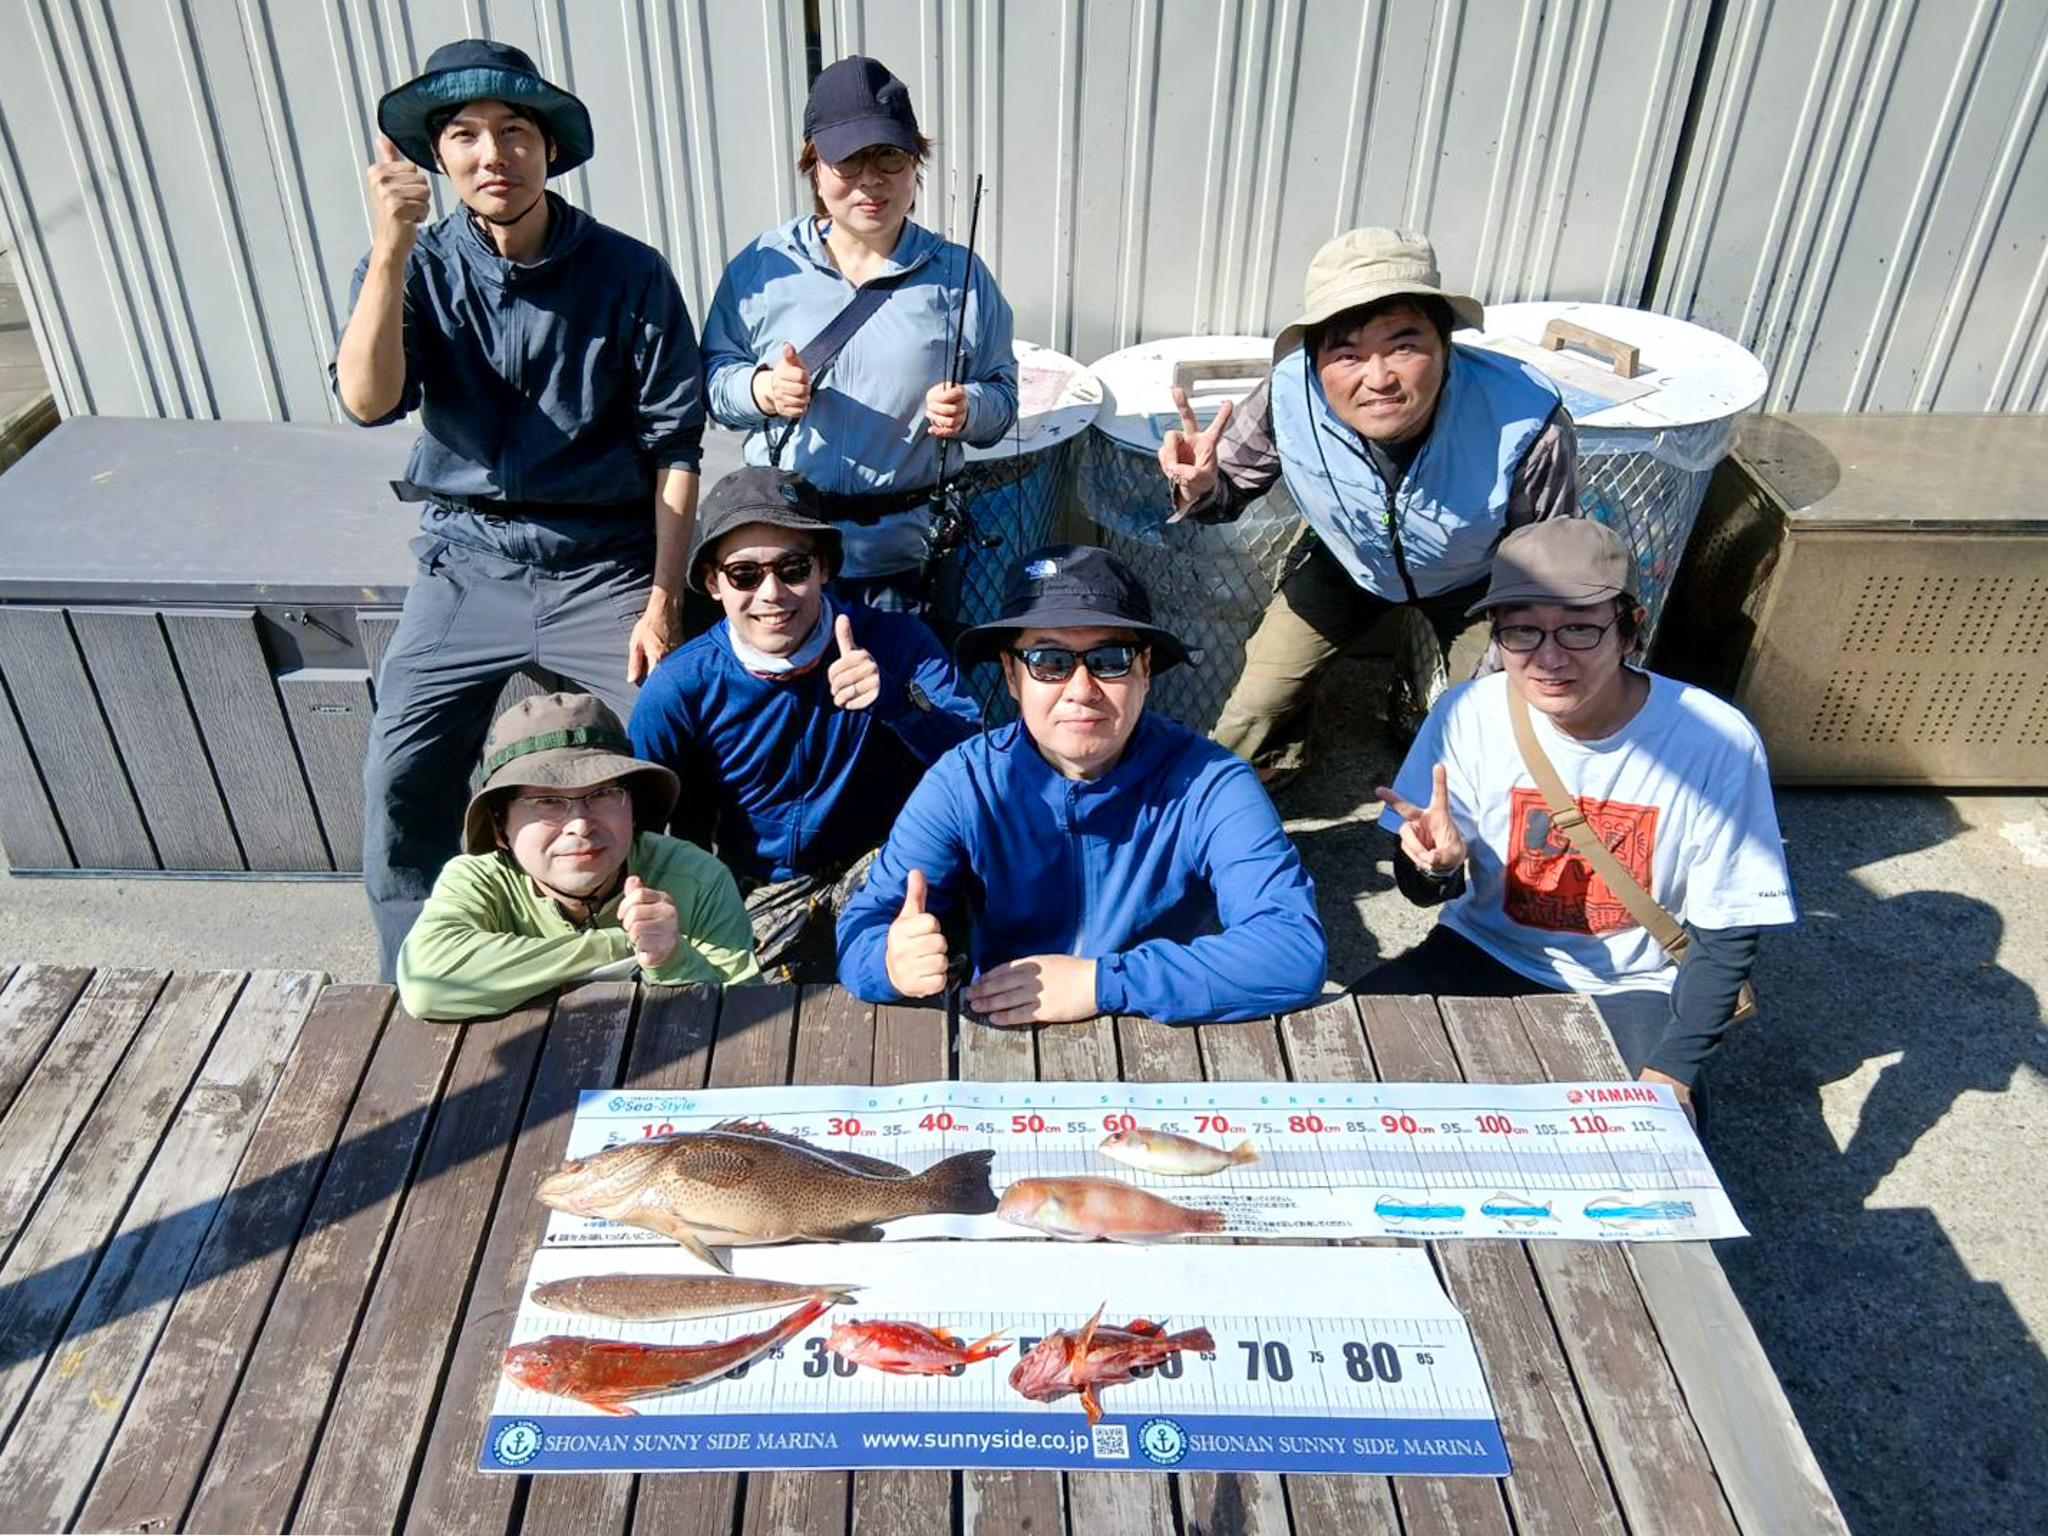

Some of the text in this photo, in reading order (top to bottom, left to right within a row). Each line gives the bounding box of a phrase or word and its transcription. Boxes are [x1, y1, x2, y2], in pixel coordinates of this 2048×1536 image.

[624, 1099, 697, 1113] Sea-Style
[1584, 1088, 1659, 1103] YAMAHA
[1238, 1340, 1294, 1381] 70
[1309, 1350, 1325, 1364] 75
[1342, 1341, 1403, 1383] 80
[1416, 1352, 1434, 1365] 85
[545, 1432, 839, 1452] SHONAN SUNNY SIDE MARINA
[862, 1431, 1090, 1453] www.sunnyside.co.jp
[1189, 1434, 1488, 1457] SHONAN SUNNY SIDE MARINA
